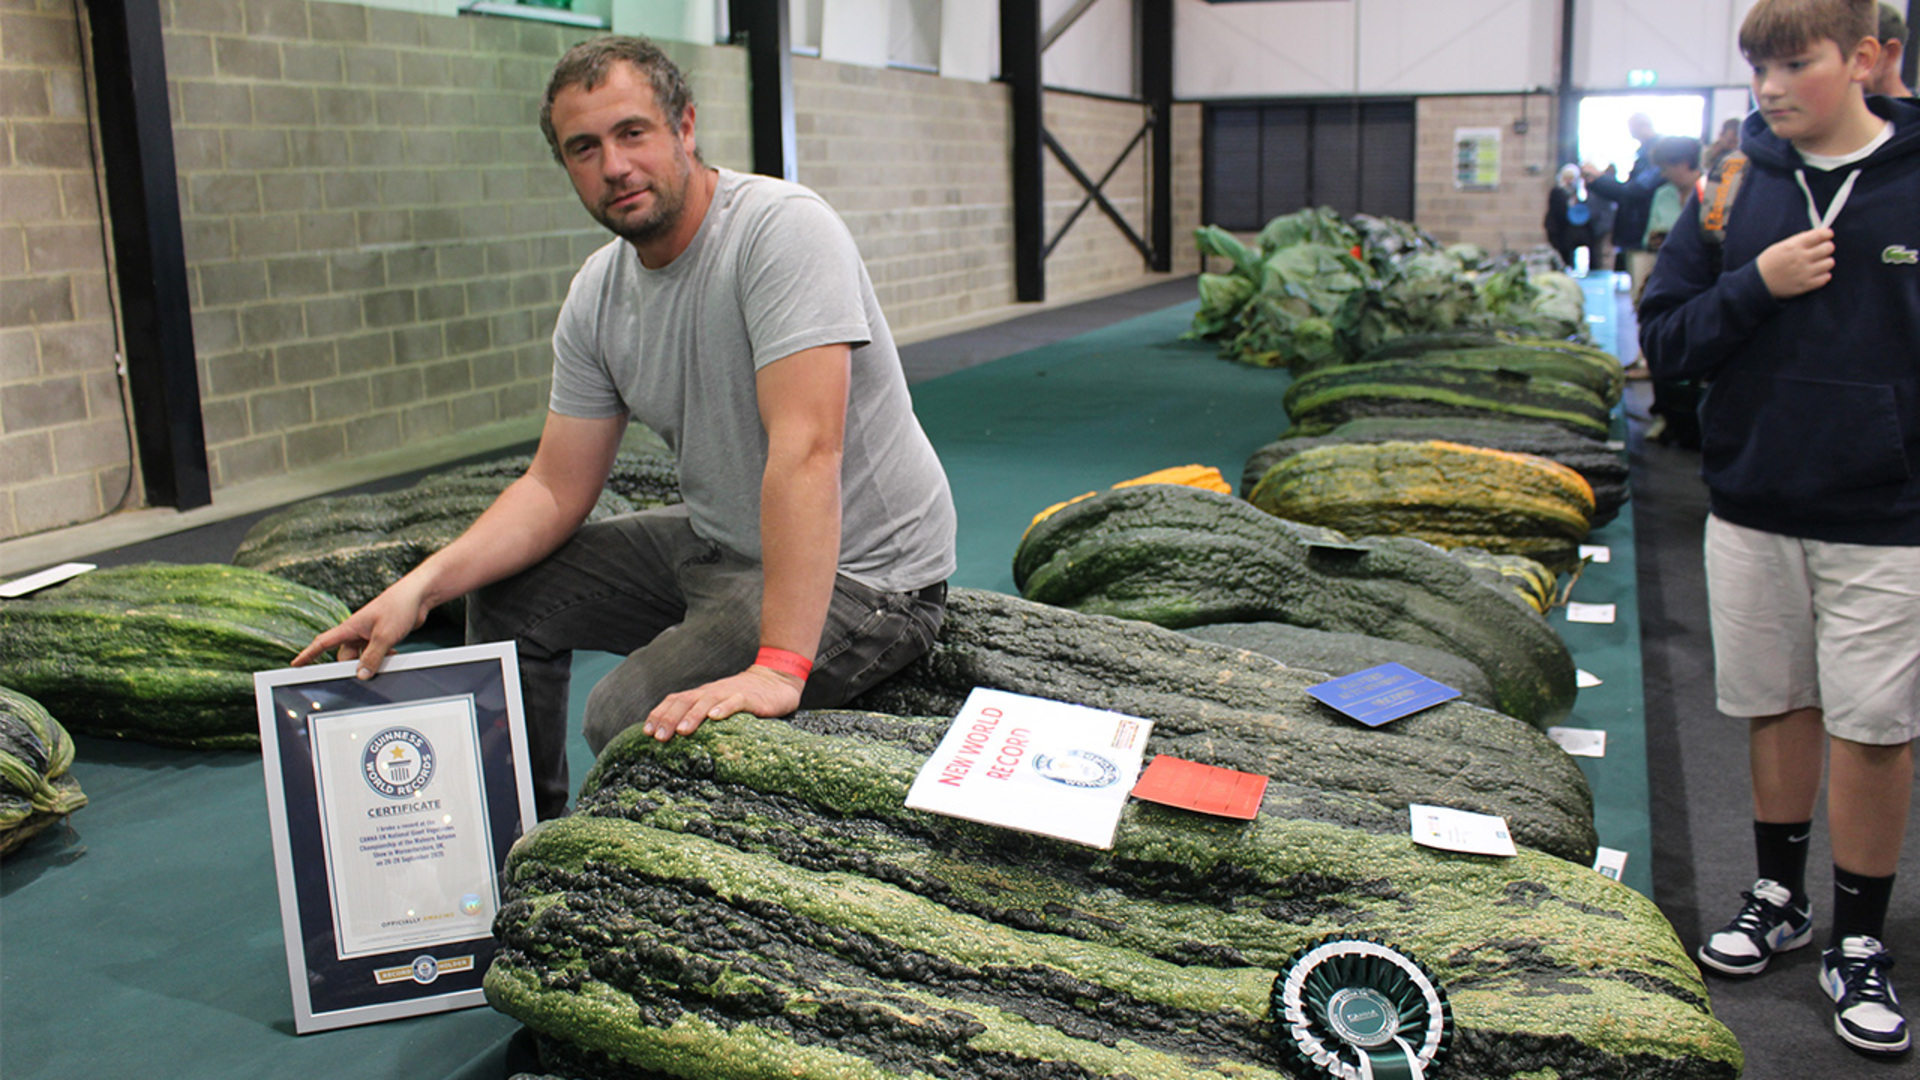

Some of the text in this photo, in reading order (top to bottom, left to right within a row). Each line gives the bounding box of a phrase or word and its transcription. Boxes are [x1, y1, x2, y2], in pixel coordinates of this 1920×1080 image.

[369, 731, 424, 755] GUINNESS
[937, 706, 1004, 788] NEW WORLD
[365, 753, 433, 796] WORLD RECORDS
[367, 799, 441, 818] CERTIFICATE
[387, 830, 410, 839] National
[381, 912, 456, 928] OFFICIALLY AMAZING
[381, 967, 412, 979] RECORD
[438, 959, 468, 970] HOLDER
